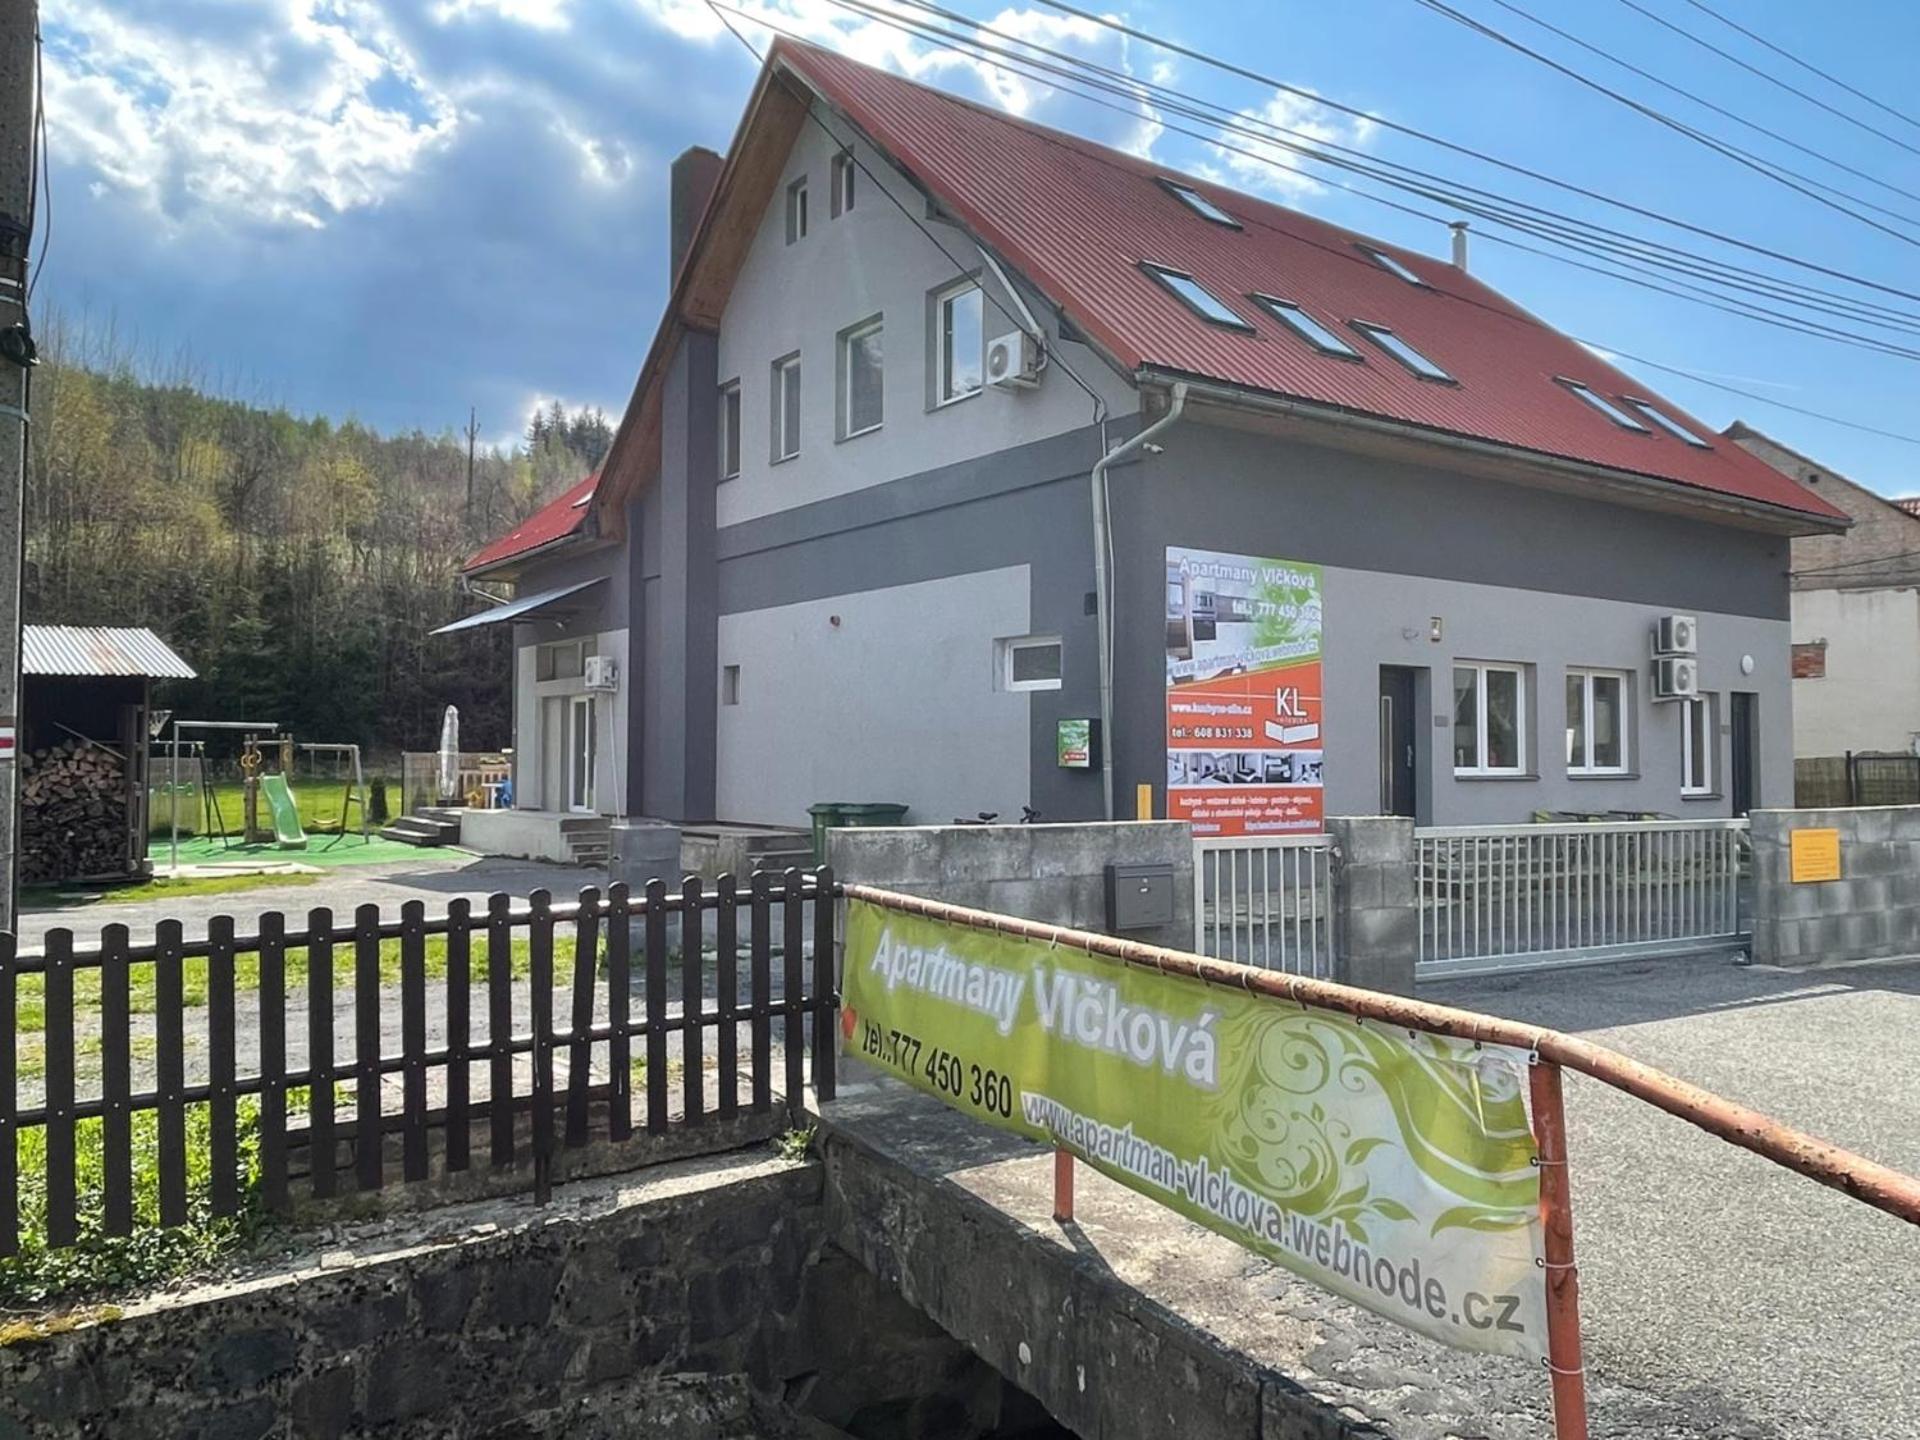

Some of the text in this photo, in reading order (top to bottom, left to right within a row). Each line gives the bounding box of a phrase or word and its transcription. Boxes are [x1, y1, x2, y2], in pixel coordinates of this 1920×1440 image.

[1179, 556, 1315, 588] Apartmany Vlčková
[1276, 687, 1307, 716] KL
[1194, 727, 1213, 738] 608
[1215, 727, 1232, 738] 831
[1236, 728, 1253, 738] 338
[871, 928, 1216, 1084] Apartmany Vlčková
[925, 1047, 962, 1096] 450
[970, 1064, 1011, 1118] 360
[1022, 1092, 1524, 1332] www.apartman-vlckova.webnode.cz
